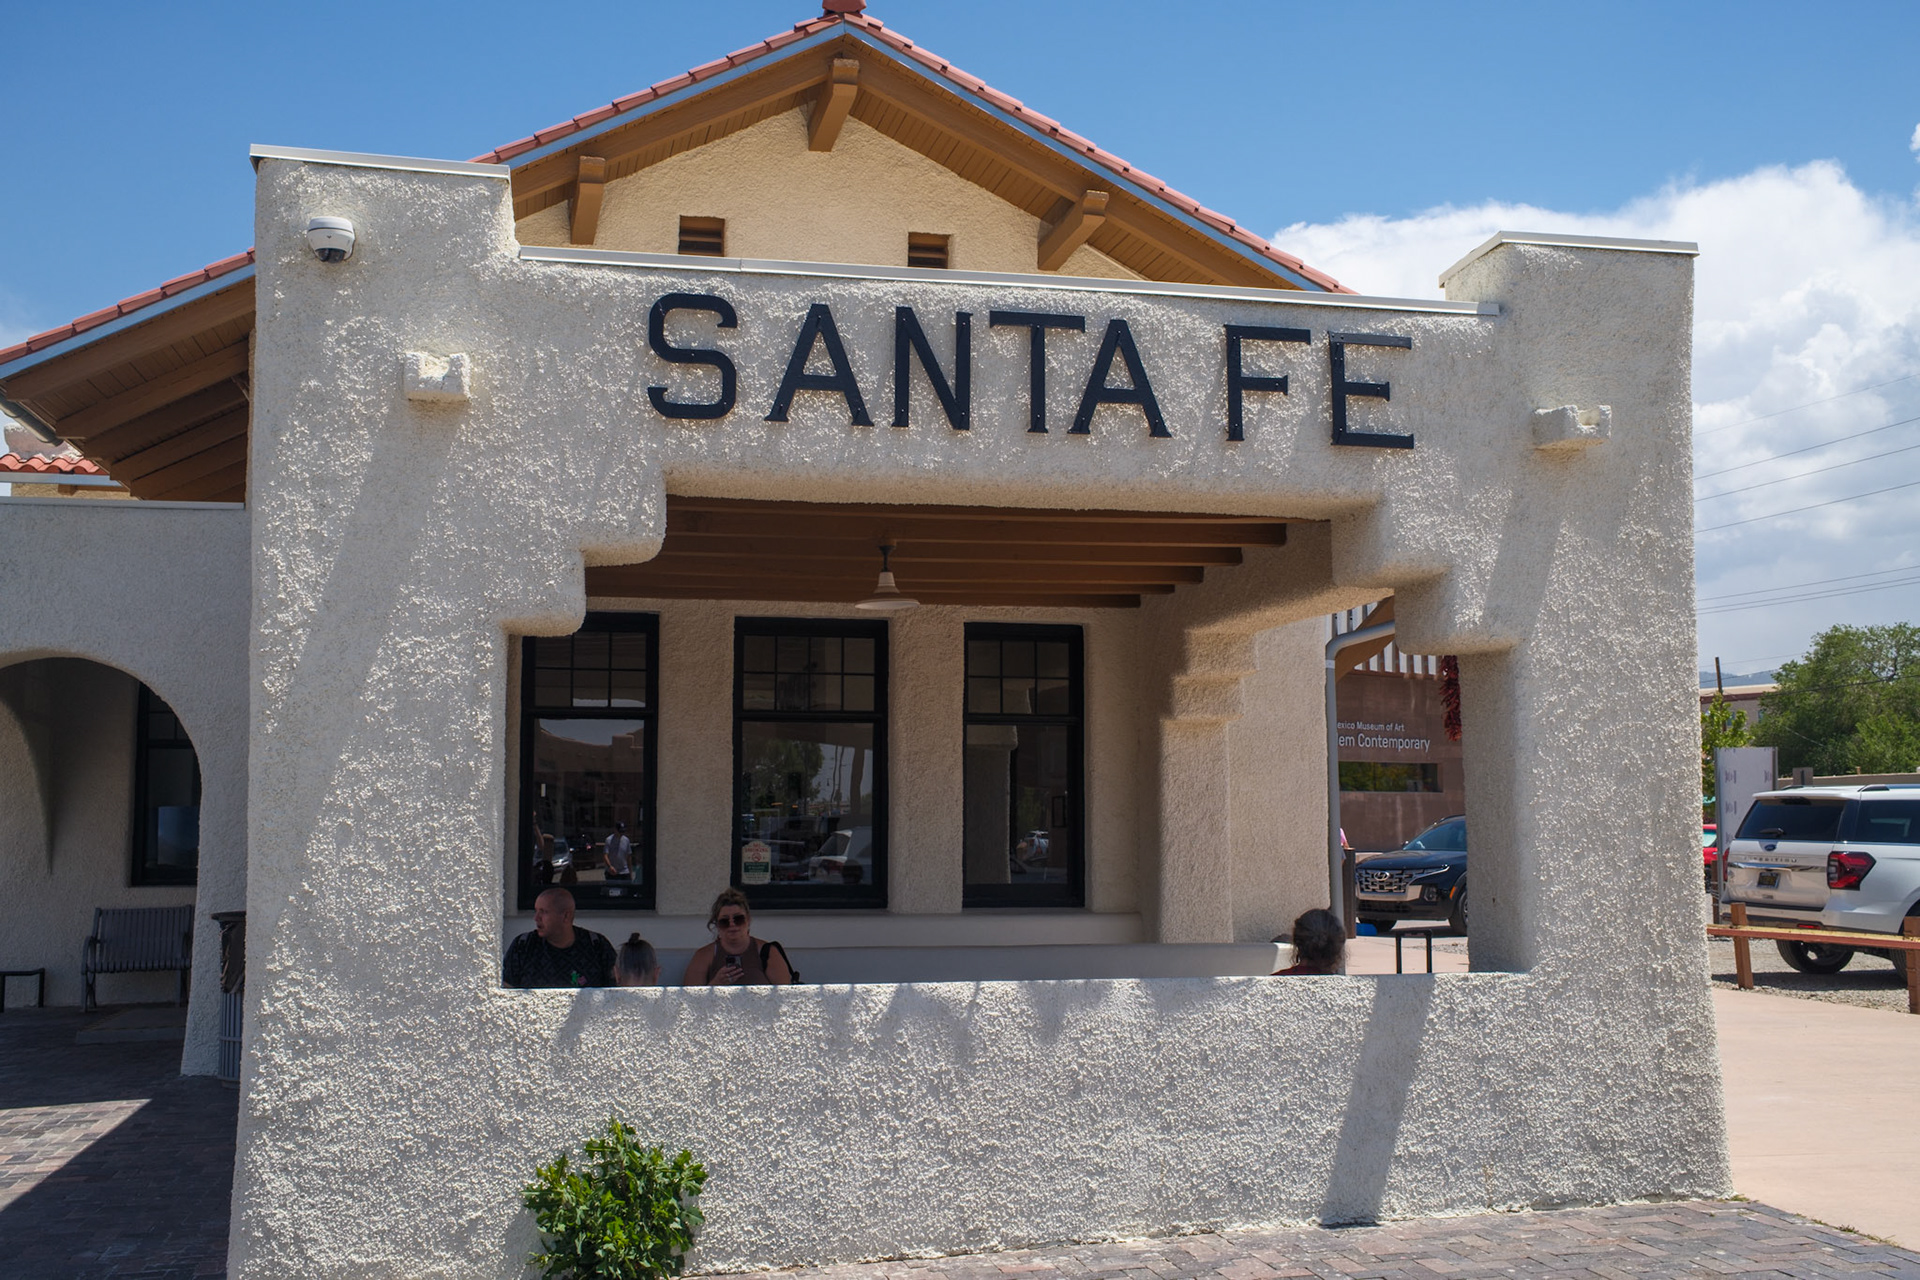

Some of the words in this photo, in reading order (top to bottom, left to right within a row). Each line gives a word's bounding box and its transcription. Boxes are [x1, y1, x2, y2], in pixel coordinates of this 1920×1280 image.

[647, 292, 1172, 439] SANTA
[1223, 323, 1415, 449] FE
[1337, 721, 1355, 730] exico
[1356, 721, 1385, 731] Museum
[1386, 722, 1393, 731] of
[1394, 723, 1405, 732] Art
[1357, 733, 1430, 752] Contemporary
